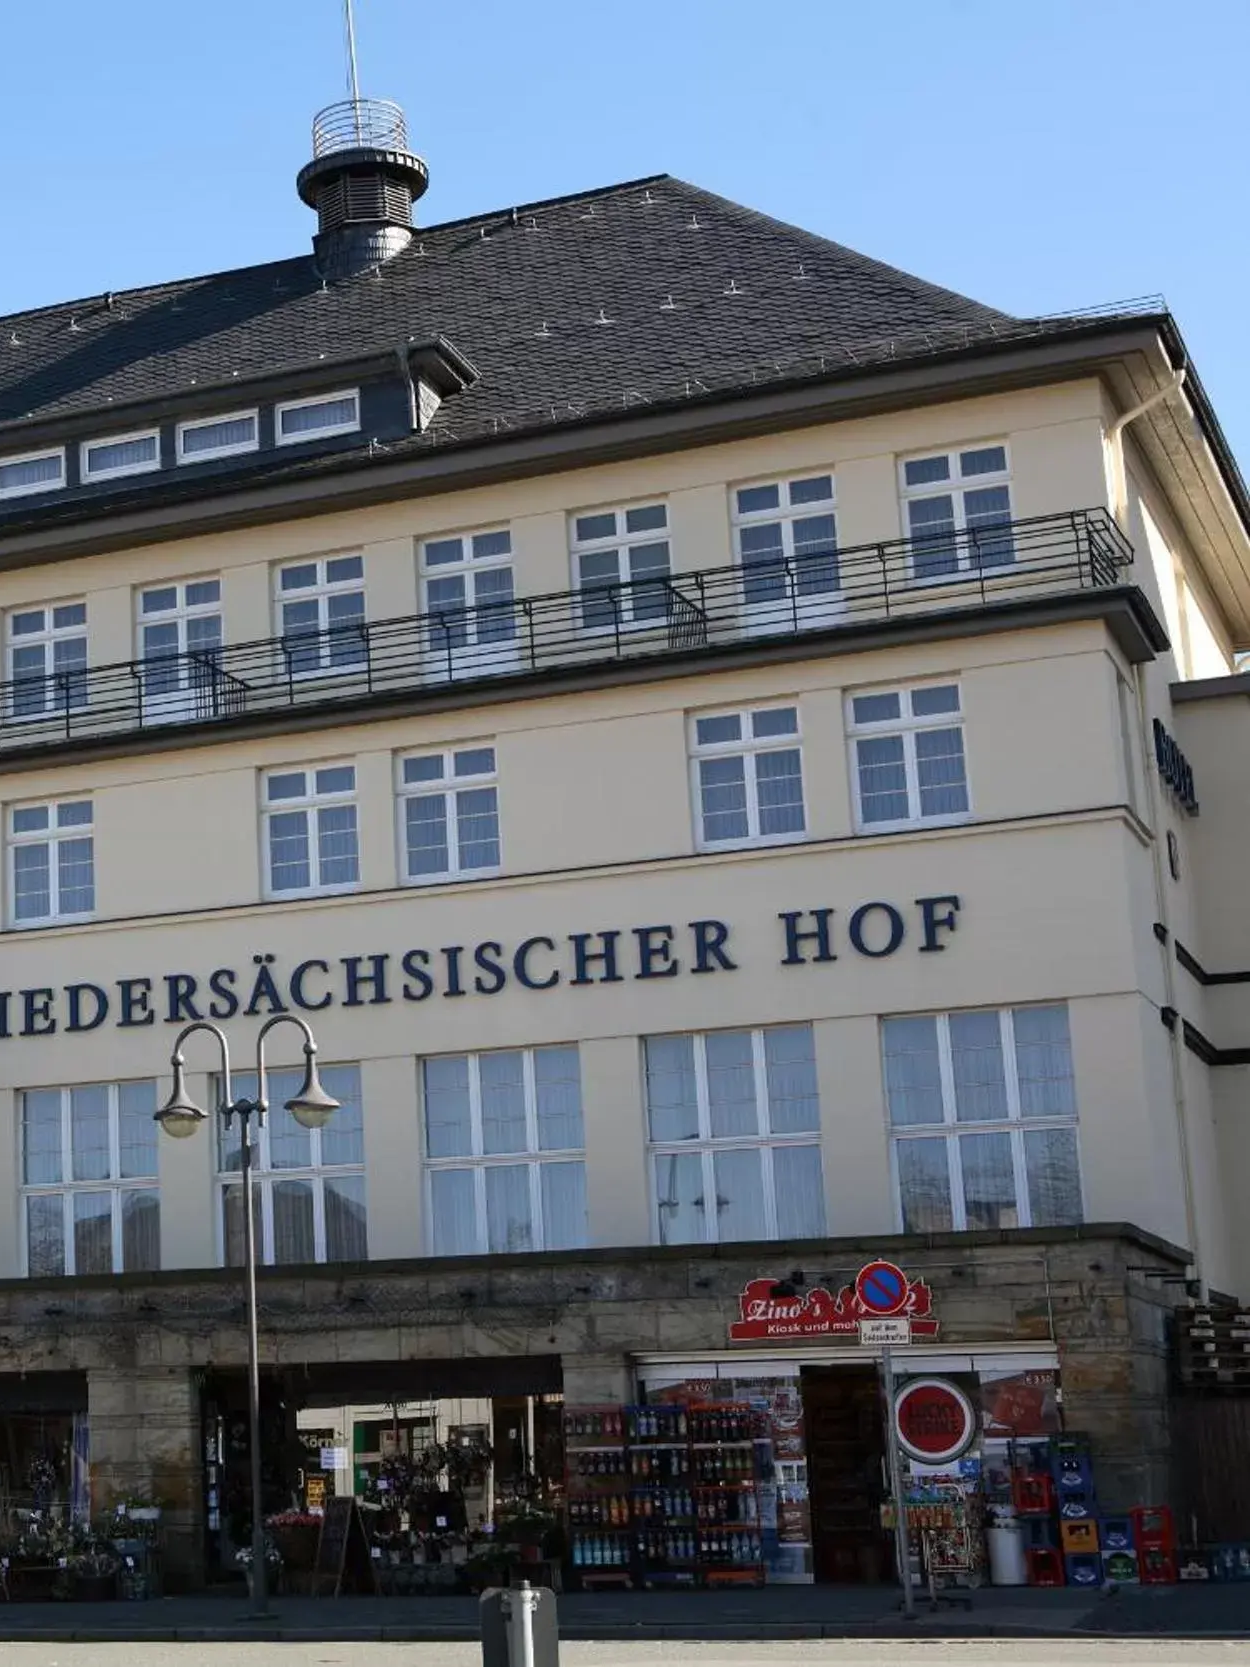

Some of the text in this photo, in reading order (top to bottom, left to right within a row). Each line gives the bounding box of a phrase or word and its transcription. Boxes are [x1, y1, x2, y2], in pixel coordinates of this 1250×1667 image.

[778, 895, 962, 965] HOF
[747, 1296, 822, 1322] Zino's
[767, 1322, 801, 1334] Kiosk
[804, 1320, 830, 1332] und
